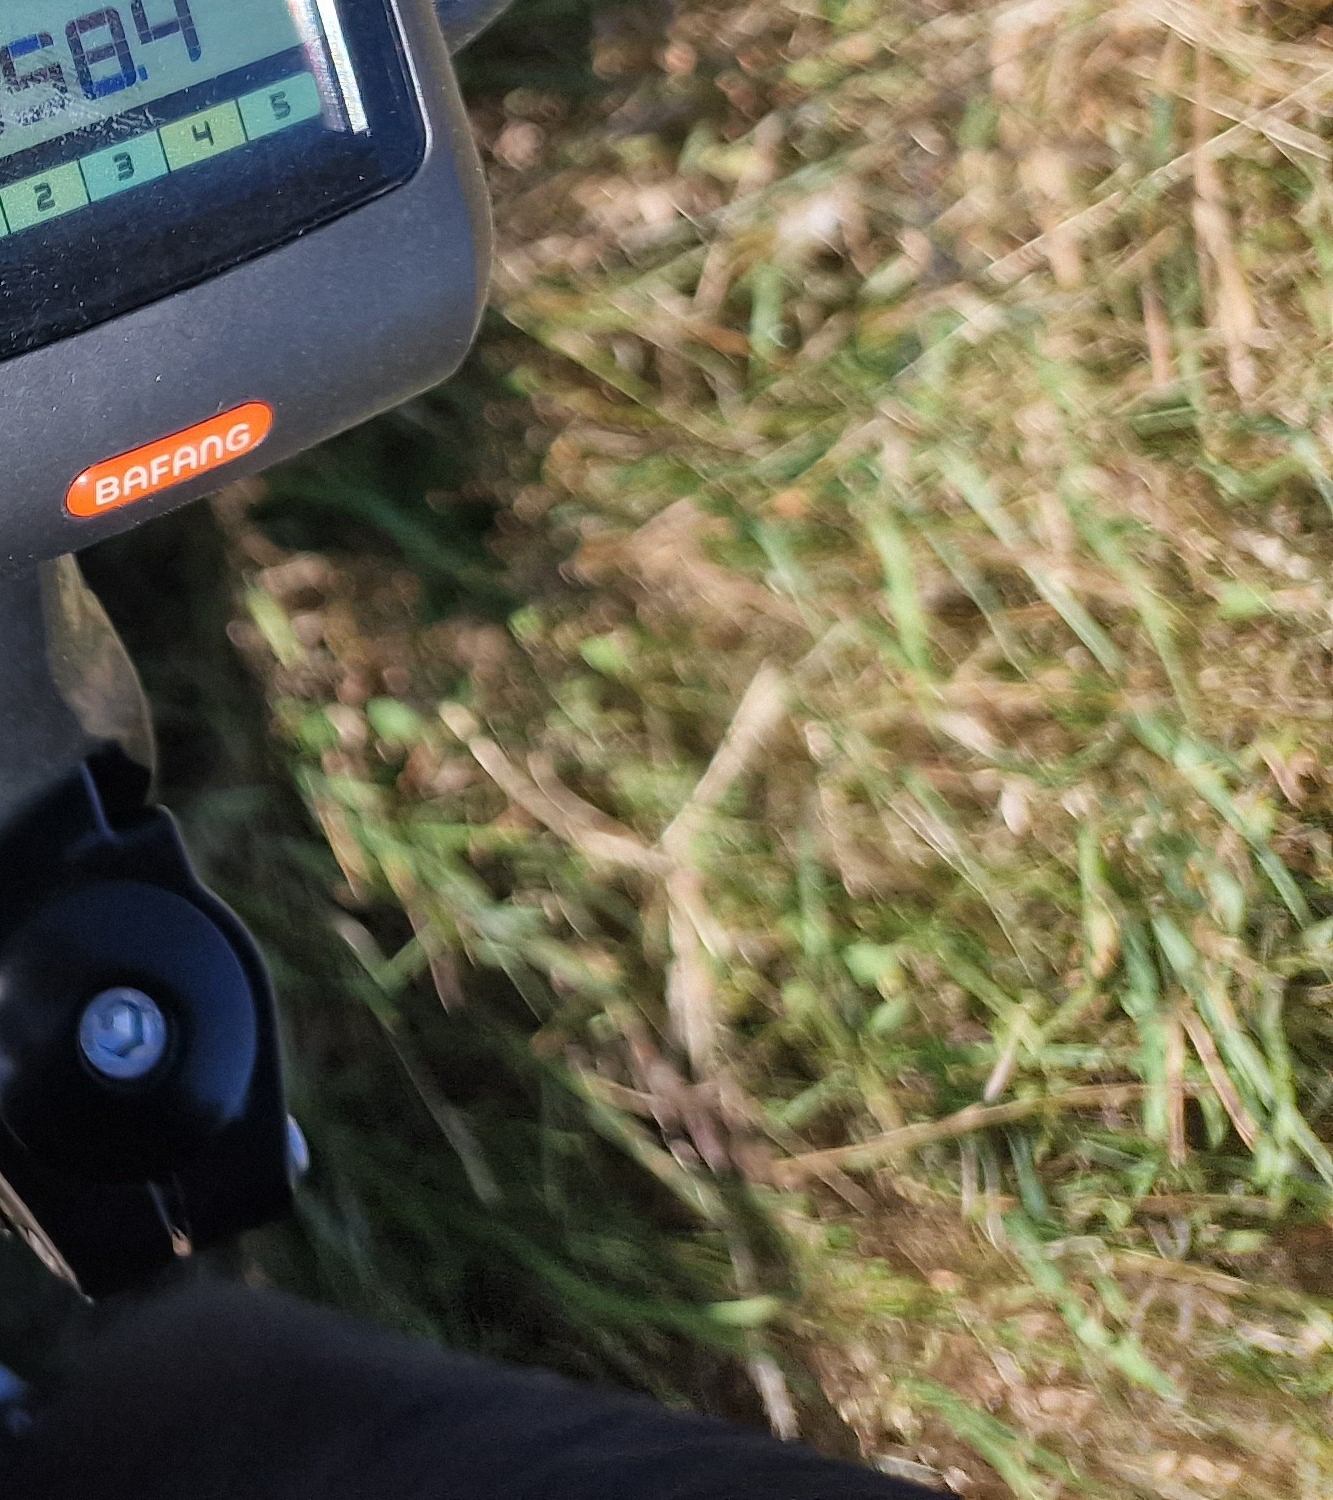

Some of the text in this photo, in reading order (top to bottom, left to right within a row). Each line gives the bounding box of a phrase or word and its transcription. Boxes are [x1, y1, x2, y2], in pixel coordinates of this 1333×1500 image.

[33, 182, 57, 213] 2
[111, 152, 135, 182] 3
[191, 121, 216, 146] 4
[268, 91, 292, 120] 5
[95, 422, 252, 506] BAFANG
